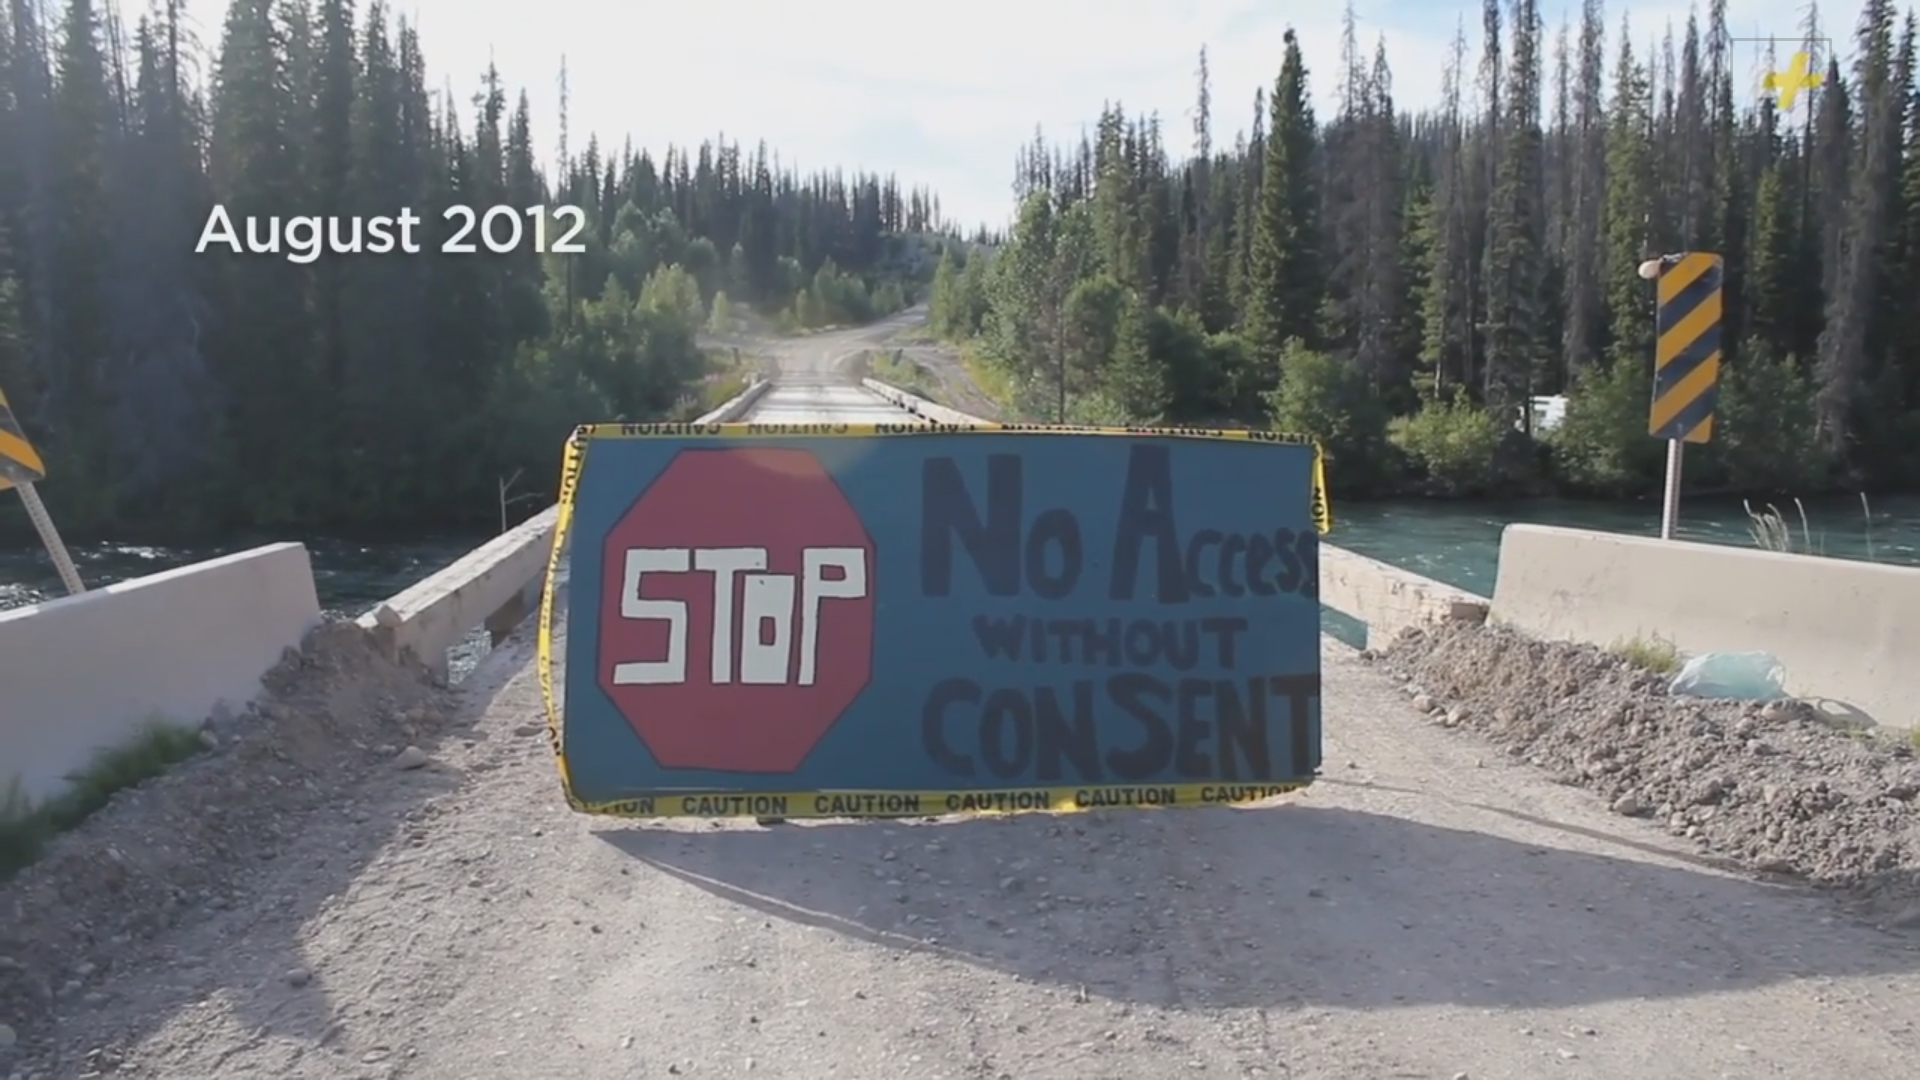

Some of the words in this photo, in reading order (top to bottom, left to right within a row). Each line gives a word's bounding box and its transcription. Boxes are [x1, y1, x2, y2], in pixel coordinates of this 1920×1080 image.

[612, 547, 868, 686] STOP
[972, 614, 1249, 671] WITHOUT
[921, 672, 1320, 781] CONSENT
[681, 796, 787, 815] CAUTION
[814, 794, 919, 814] CAUTION
[945, 791, 1050, 811] CAUTION
[1075, 787, 1176, 808] CAUTION
